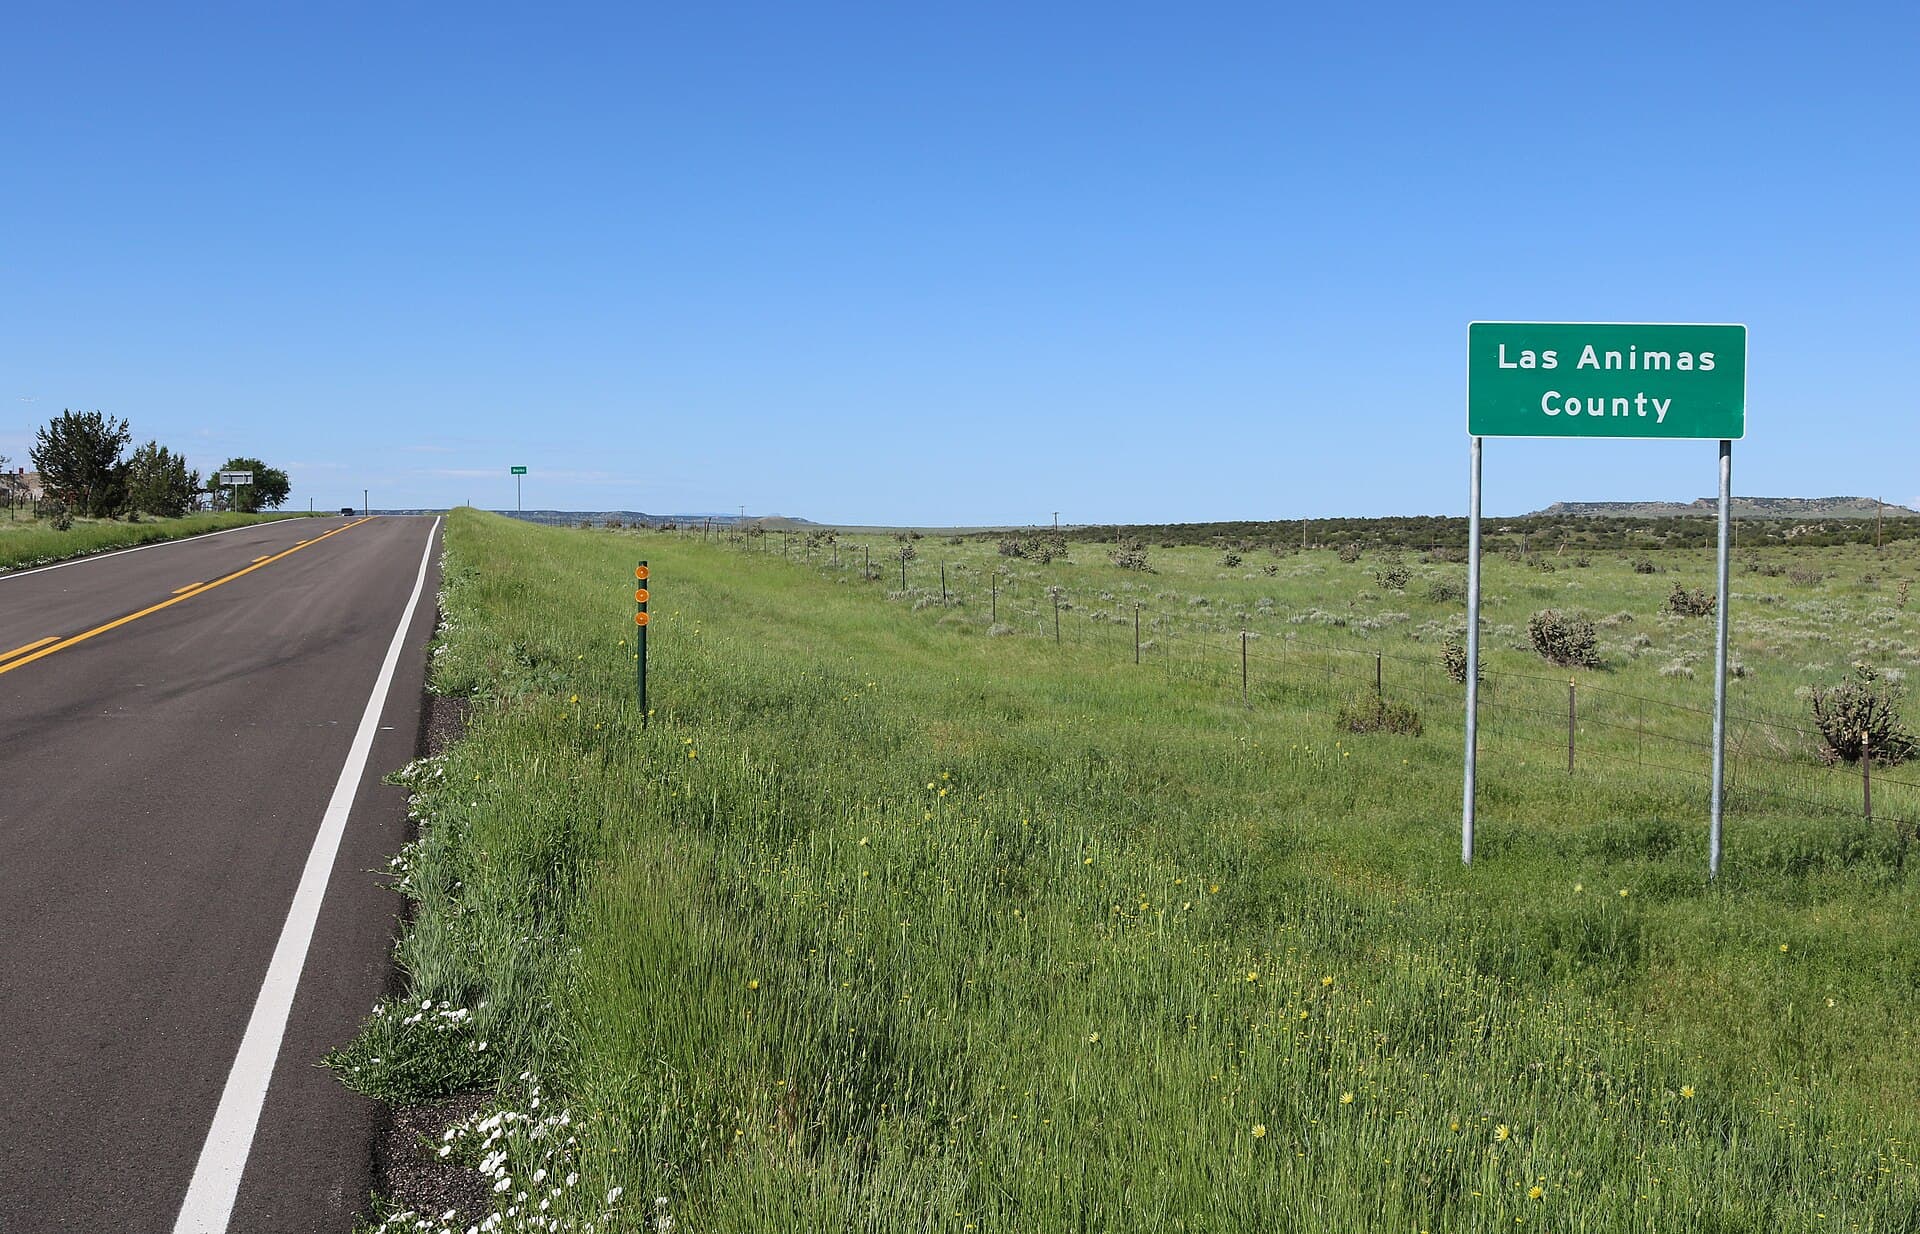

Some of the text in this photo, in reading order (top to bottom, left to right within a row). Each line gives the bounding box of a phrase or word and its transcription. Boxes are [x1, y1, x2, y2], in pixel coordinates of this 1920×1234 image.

[1498, 343, 1715, 371] Las Animas
[1541, 390, 1672, 424] County
